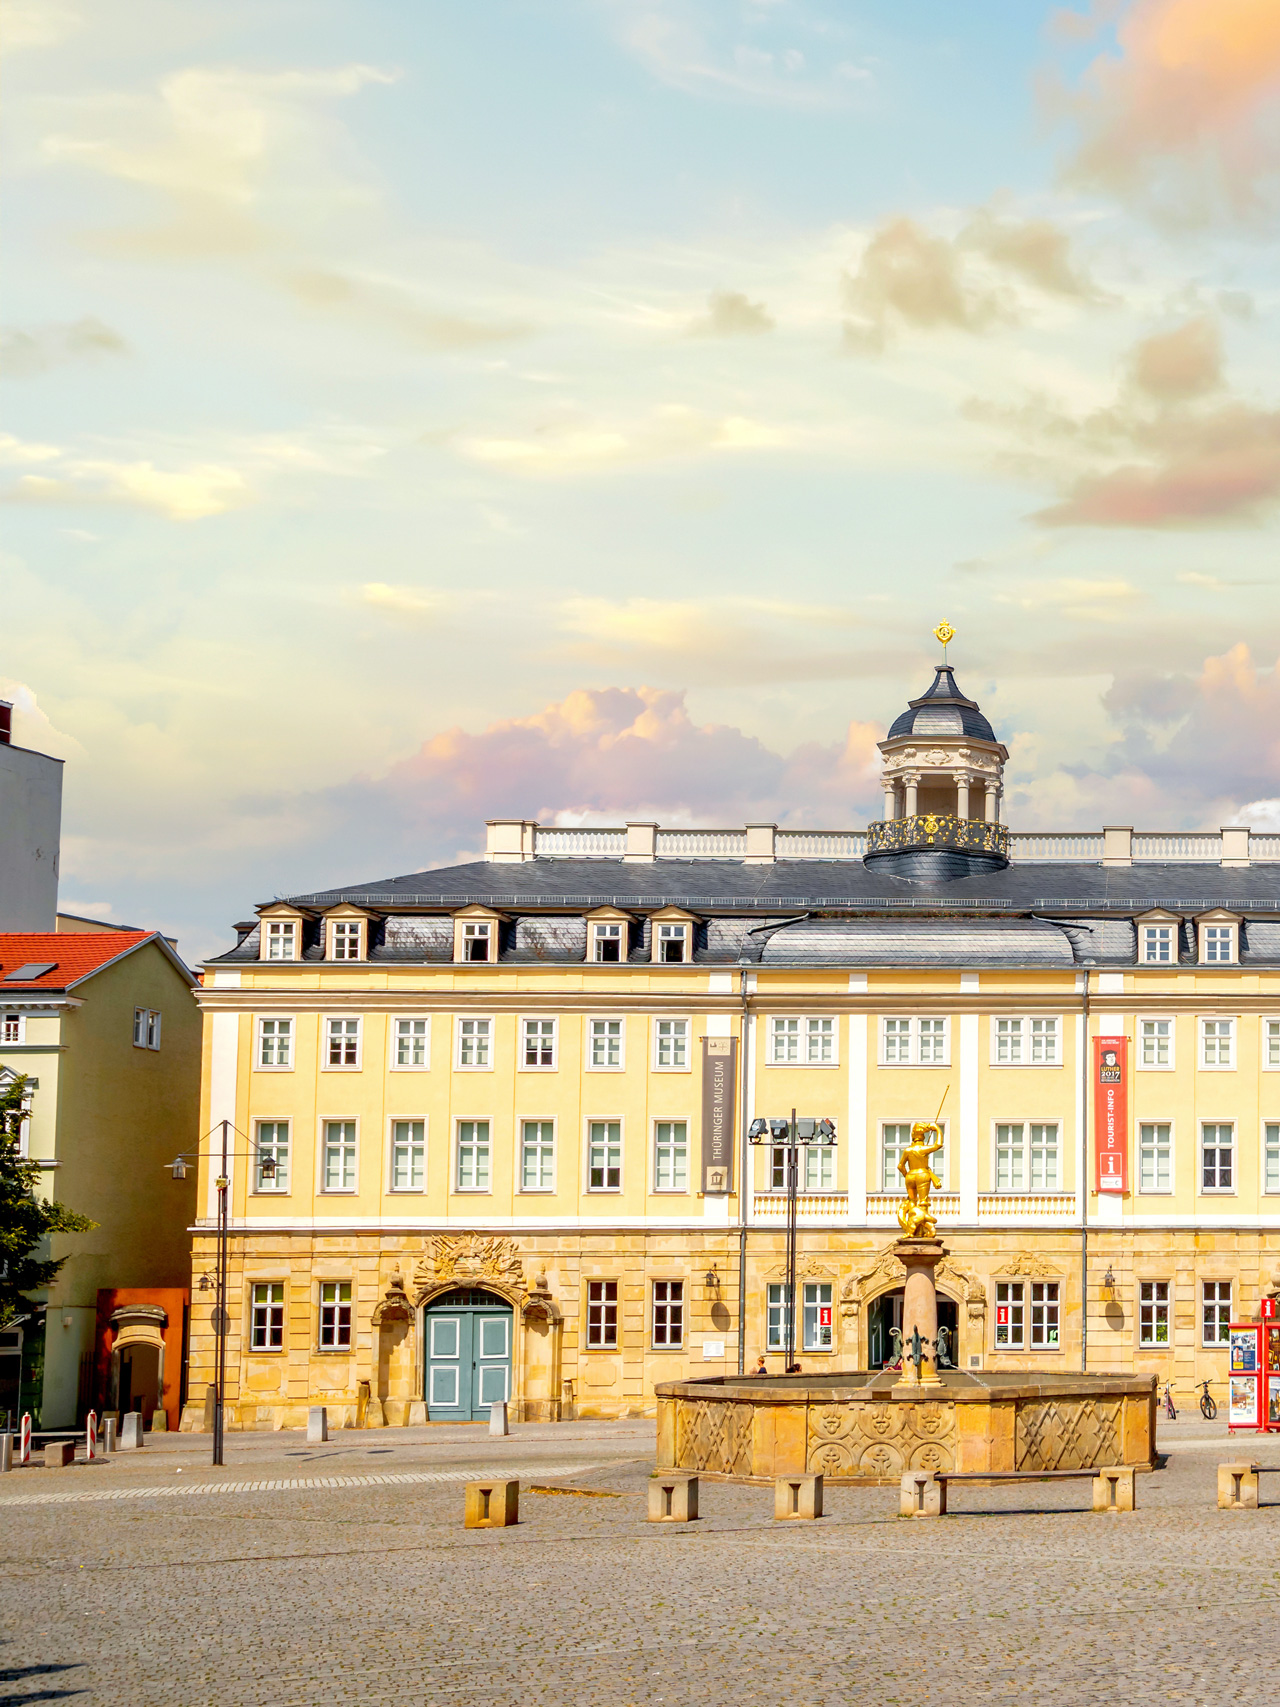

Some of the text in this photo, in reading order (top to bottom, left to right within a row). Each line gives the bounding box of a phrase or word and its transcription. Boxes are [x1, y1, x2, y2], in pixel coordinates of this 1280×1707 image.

[1101, 1071, 1120, 1079] 2017
[713, 1061, 724, 1160] THÜRINGER MUSEUM
[1107, 1156, 1115, 1174] i
[999, 1308, 1006, 1323] i
[1265, 1300, 1272, 1316] i
[822, 1310, 829, 1324] i
